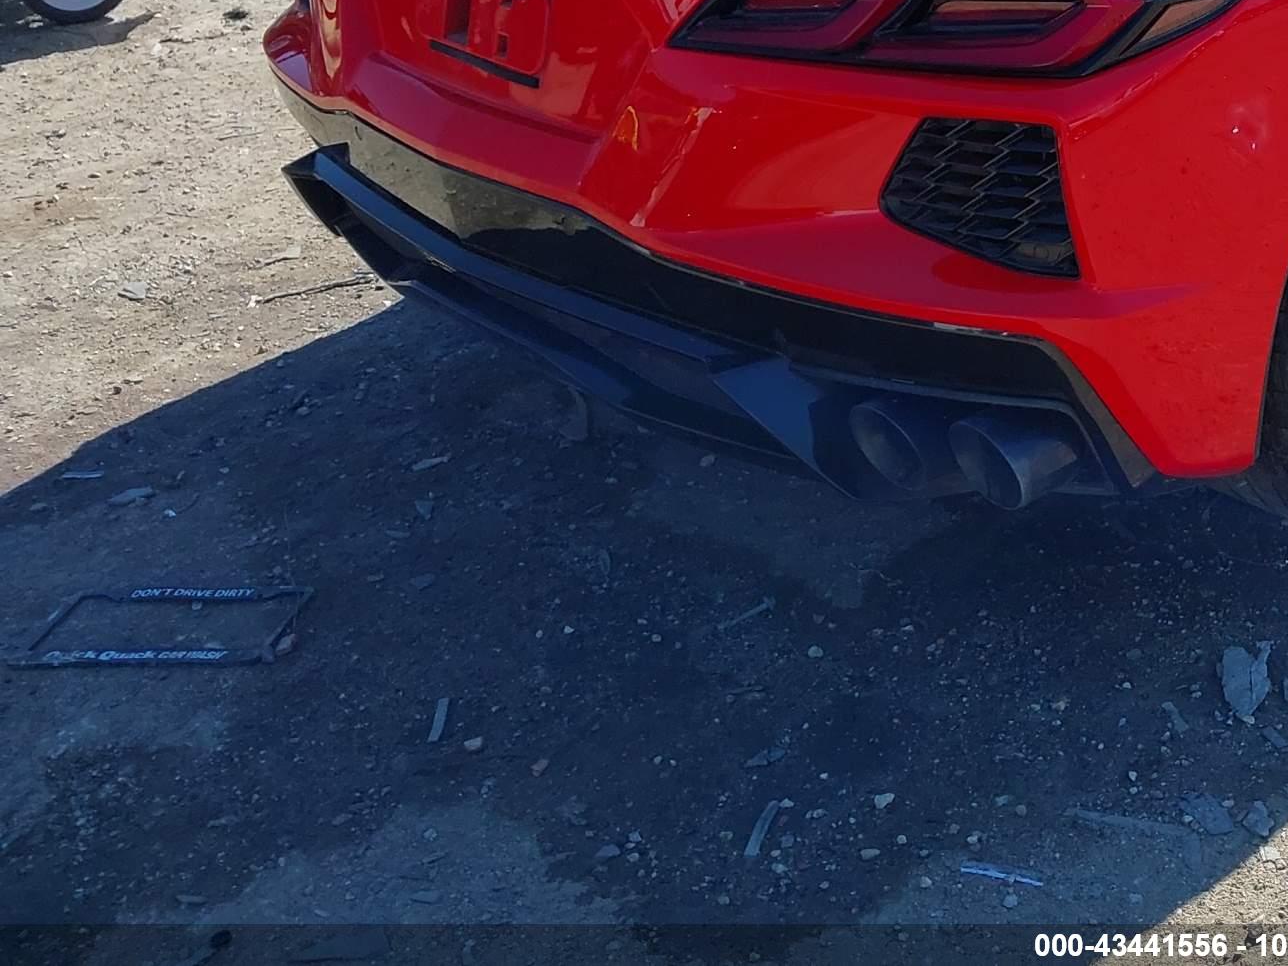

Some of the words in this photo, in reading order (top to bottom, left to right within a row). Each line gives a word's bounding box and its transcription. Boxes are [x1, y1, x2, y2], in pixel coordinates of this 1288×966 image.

[131, 588, 174, 598] DON'T
[174, 588, 214, 598] DRIVE
[214, 588, 255, 598] DIRTY
